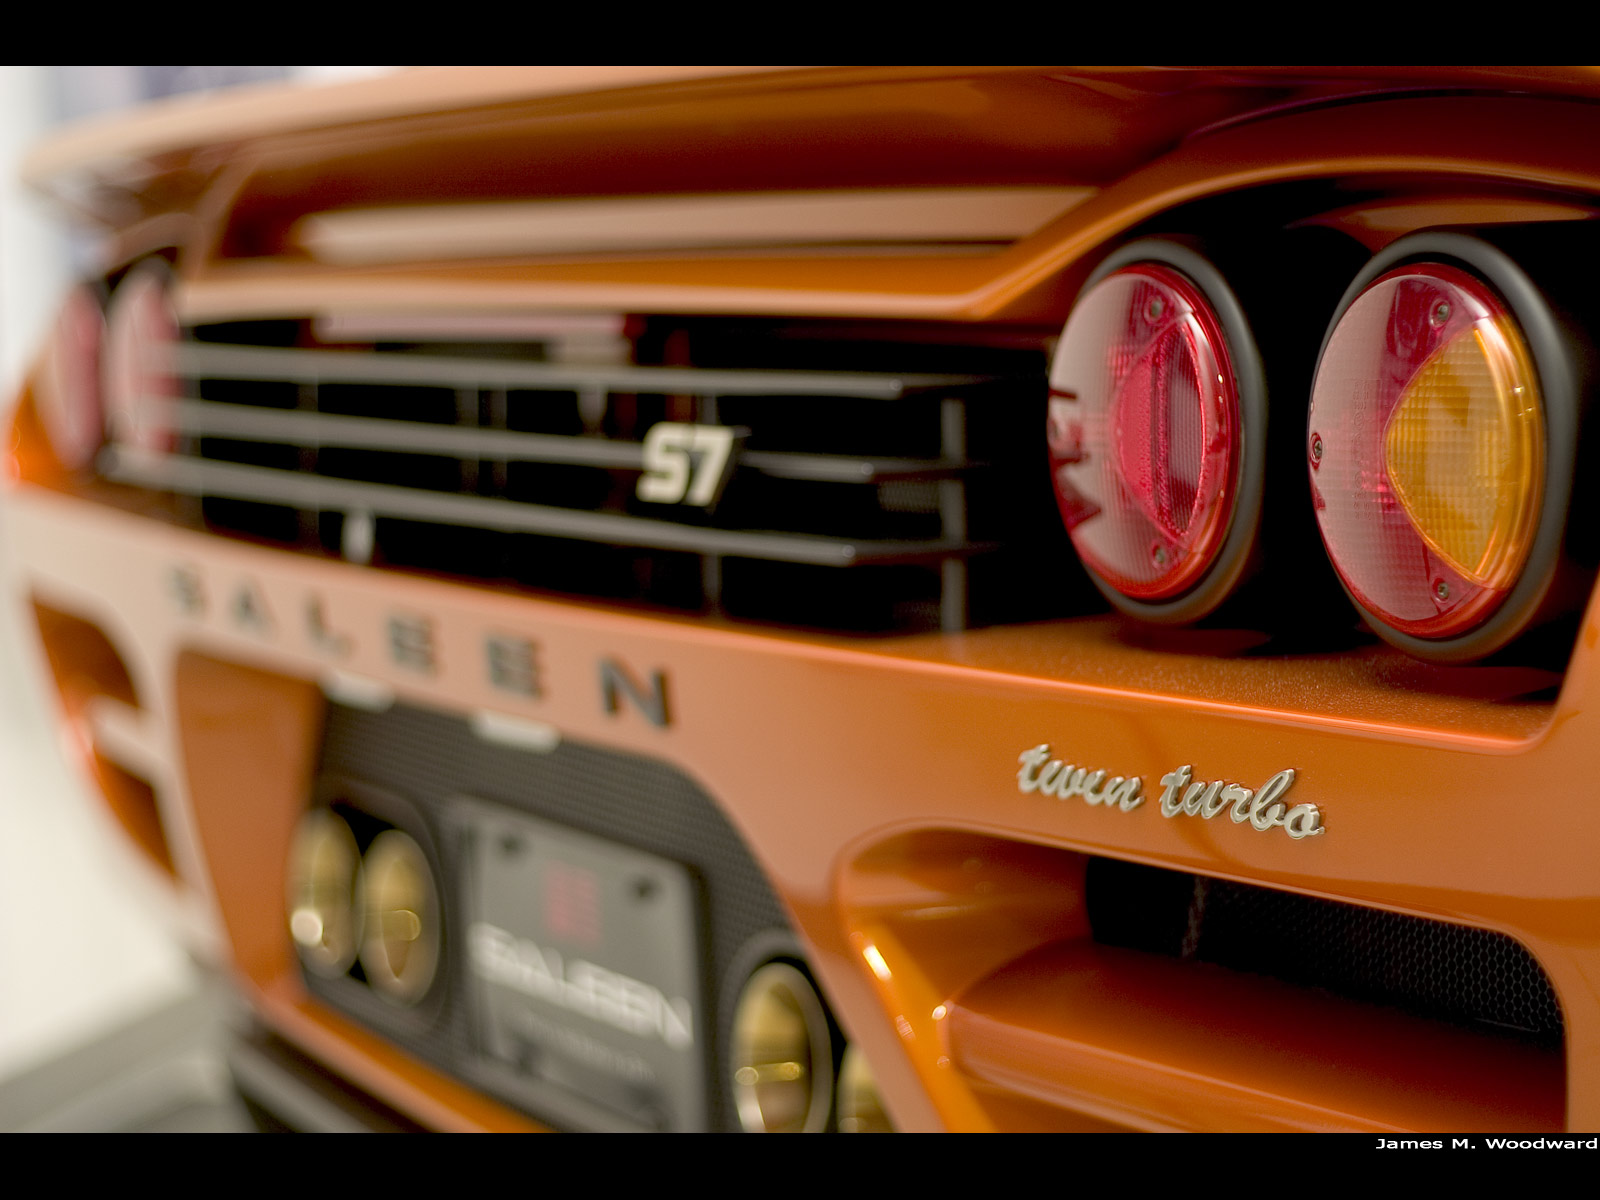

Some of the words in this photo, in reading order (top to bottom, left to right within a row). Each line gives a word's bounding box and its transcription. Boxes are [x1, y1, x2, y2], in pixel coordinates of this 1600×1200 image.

[635, 421, 734, 506] S7
[168, 564, 676, 730] SALEEN
[1018, 744, 1145, 812] twin
[1160, 765, 1326, 840] turbo
[467, 922, 694, 1047] SALEEN
